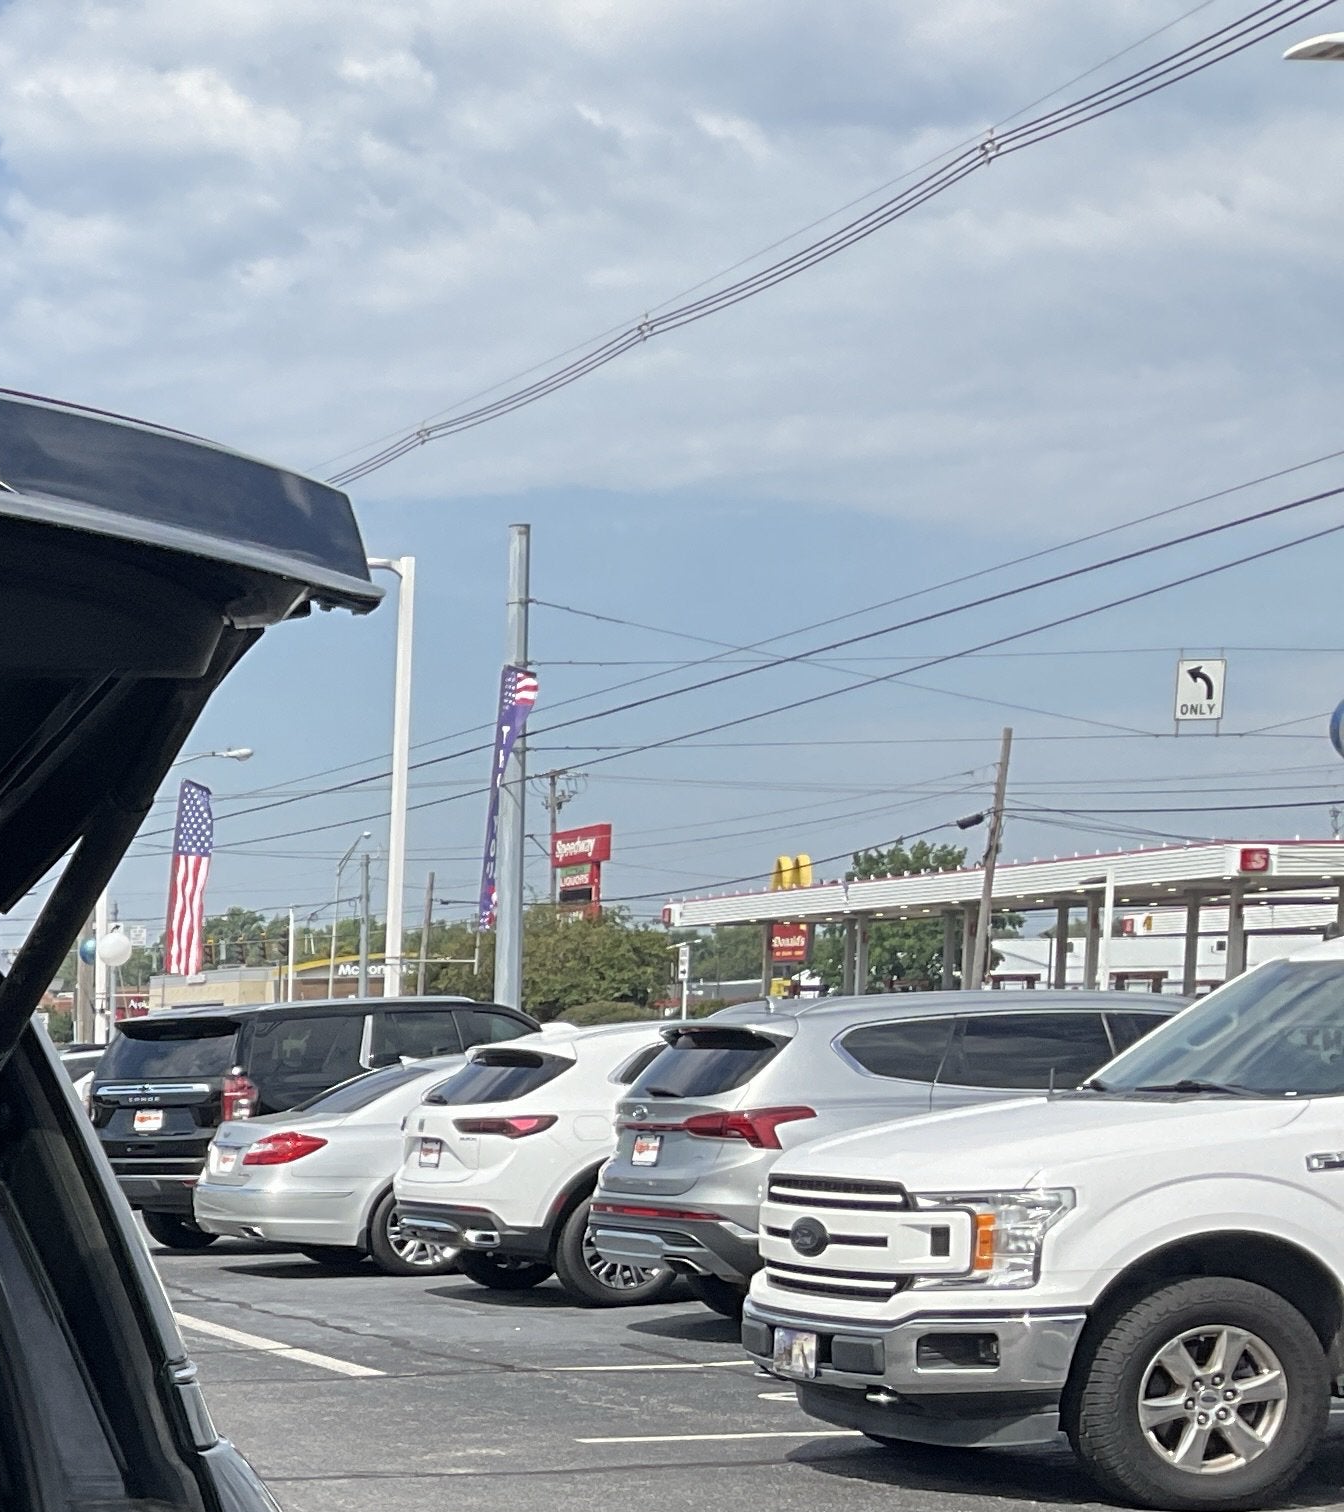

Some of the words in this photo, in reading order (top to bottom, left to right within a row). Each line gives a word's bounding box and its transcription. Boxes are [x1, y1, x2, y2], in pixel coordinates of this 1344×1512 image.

[1180, 703, 1216, 716] ONLY
[554, 836, 596, 862] Speedway
[560, 873, 590, 888] LIQUORS
[771, 935, 805, 948] Donald's
